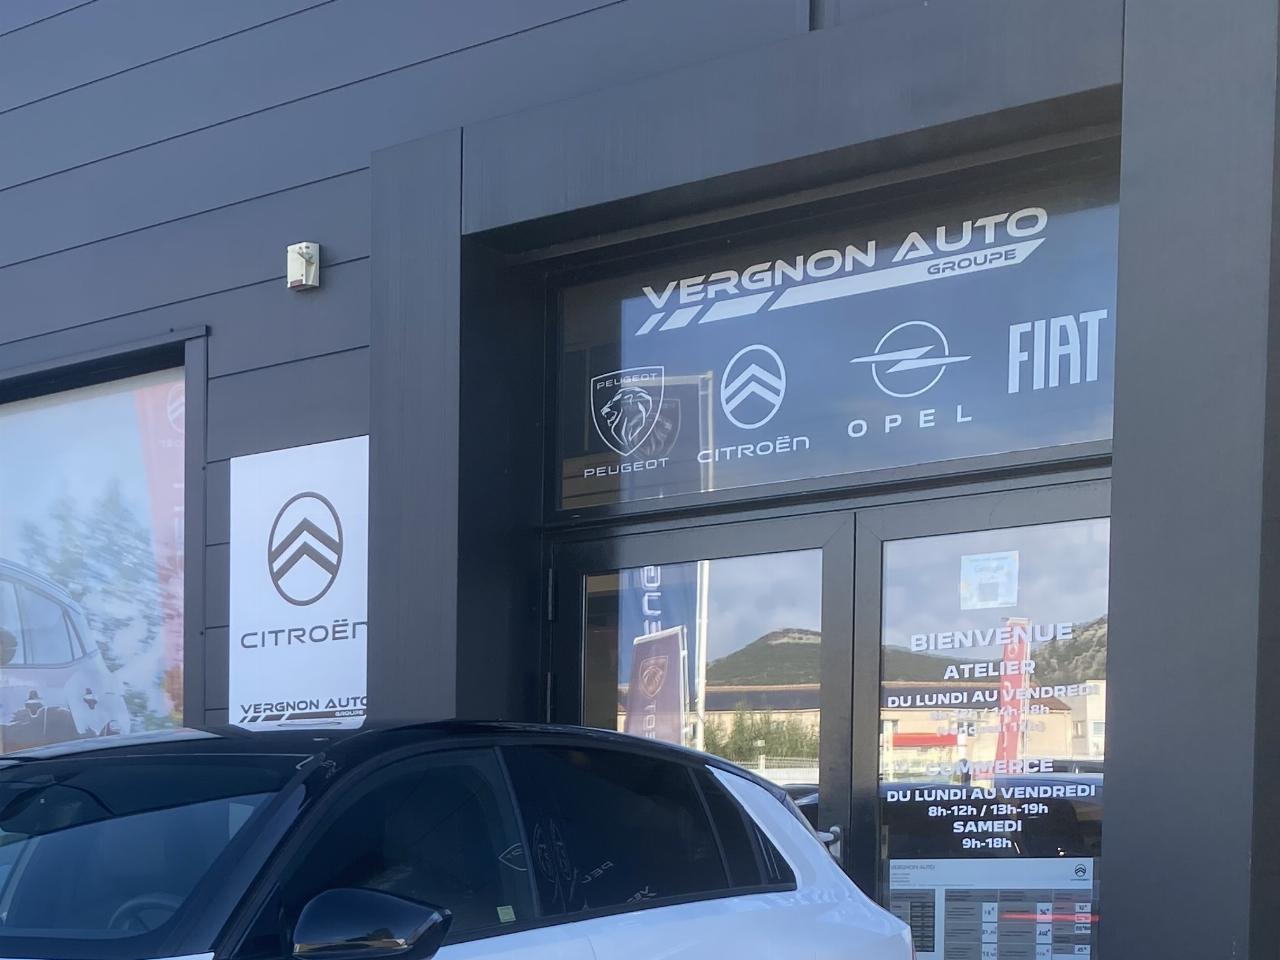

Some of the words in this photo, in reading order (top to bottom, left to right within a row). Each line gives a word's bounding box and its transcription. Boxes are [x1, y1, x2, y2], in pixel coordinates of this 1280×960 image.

[642, 240, 876, 309] VERGNON
[892, 206, 1048, 263] AUTO
[927, 248, 1017, 275] GROUPE
[1008, 309, 1108, 394] FIAT
[596, 373, 658, 389] PEUGEOT
[847, 404, 972, 438] OPEL
[584, 458, 669, 478] PEUGEOT
[910, 622, 1073, 651] BIENVENUE
[943, 660, 1035, 680] ATELIER
[240, 699, 319, 714] VERGNON
[888, 695, 913, 707] DU
[916, 691, 967, 706] LUNDI
[972, 689, 998, 702] AU
[924, 759, 1054, 776] COMMERCE
[887, 790, 911, 802] DU
[915, 788, 967, 801] LUNDI
[970, 787, 997, 799] AU
[1001, 784, 1096, 798] VENDREDI
[928, 805, 977, 817] 8h-12h
[979, 804, 987, 817] /
[990, 803, 1049, 815] 13h-19h
[953, 820, 1022, 833] SAMEDI
[962, 837, 1012, 849] 9h-18h
